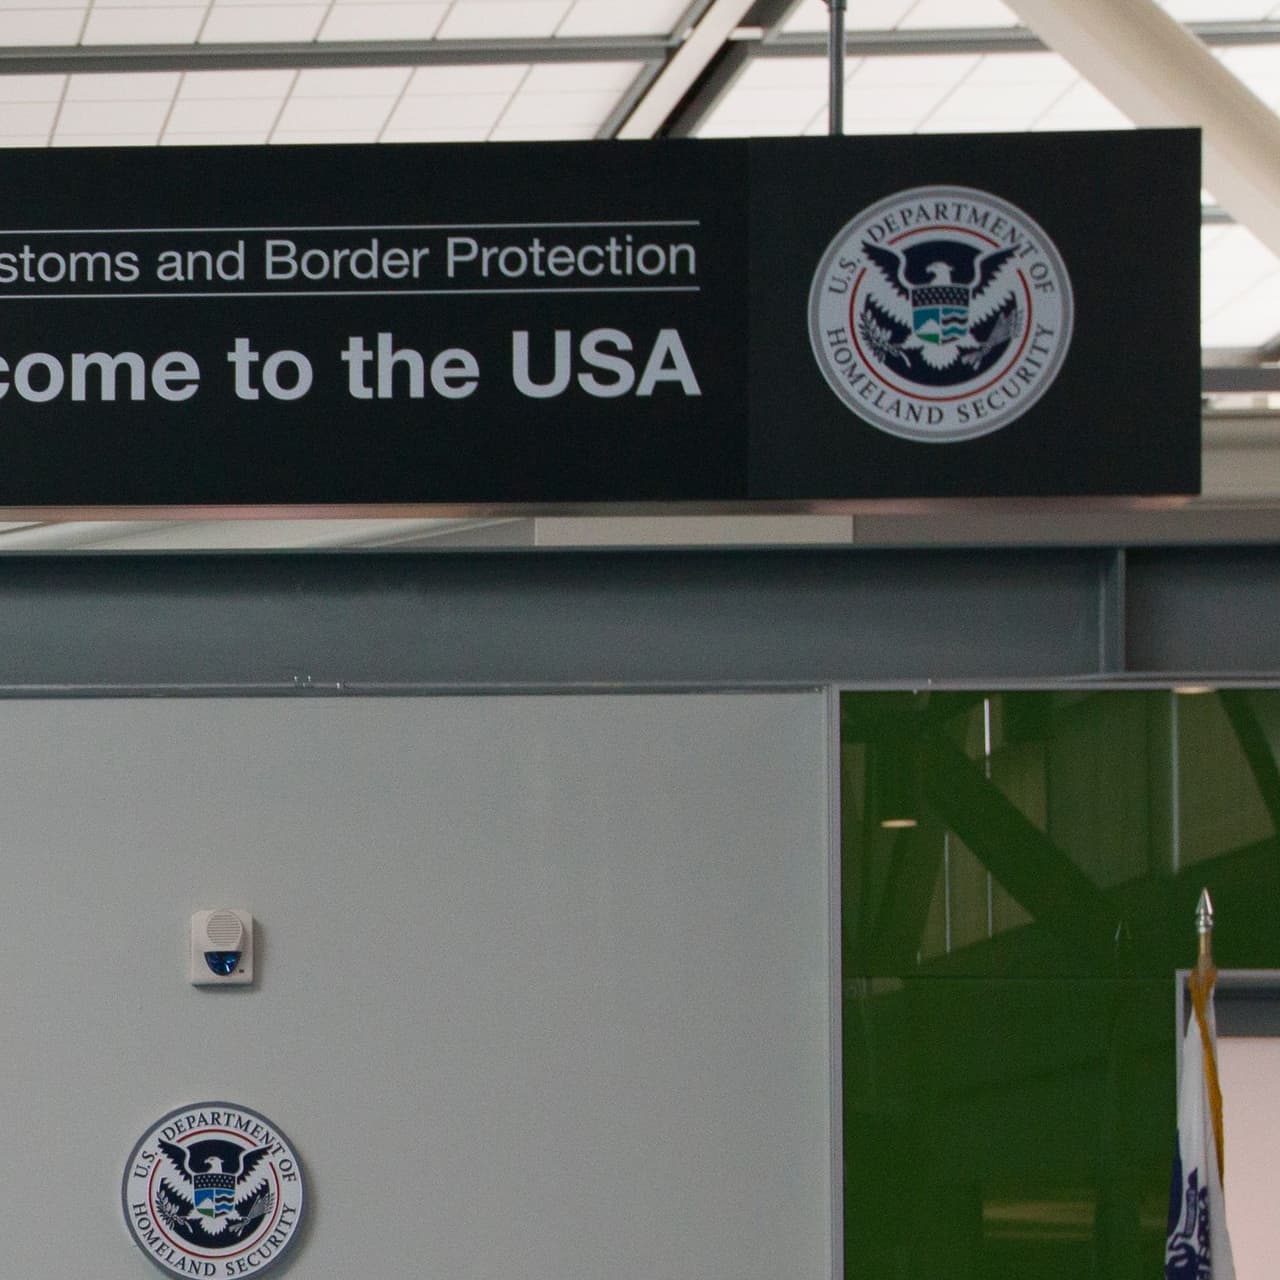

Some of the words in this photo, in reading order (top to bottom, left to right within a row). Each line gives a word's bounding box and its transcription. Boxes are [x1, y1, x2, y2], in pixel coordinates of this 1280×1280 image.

[157, 240, 245, 281] and
[266, 238, 429, 280] Border
[446, 235, 695, 278] Protection
[828, 256, 862, 295] U.S.
[866, 203, 1039, 260] DEPARTMENT
[1028, 262, 1055, 294] OF
[226, 337, 313, 401] to
[340, 332, 481, 400] the
[511, 327, 702, 398] USA
[827, 327, 945, 425] HOMELAND
[956, 323, 1055, 424] SECURITY
[133, 1150, 159, 1179] U.S.
[160, 1111, 286, 1156] DEPARTMENT
[278, 1159, 297, 1182] OF
[132, 1202, 217, 1277] HOMELAND
[226, 1204, 297, 1277] SECURITY
